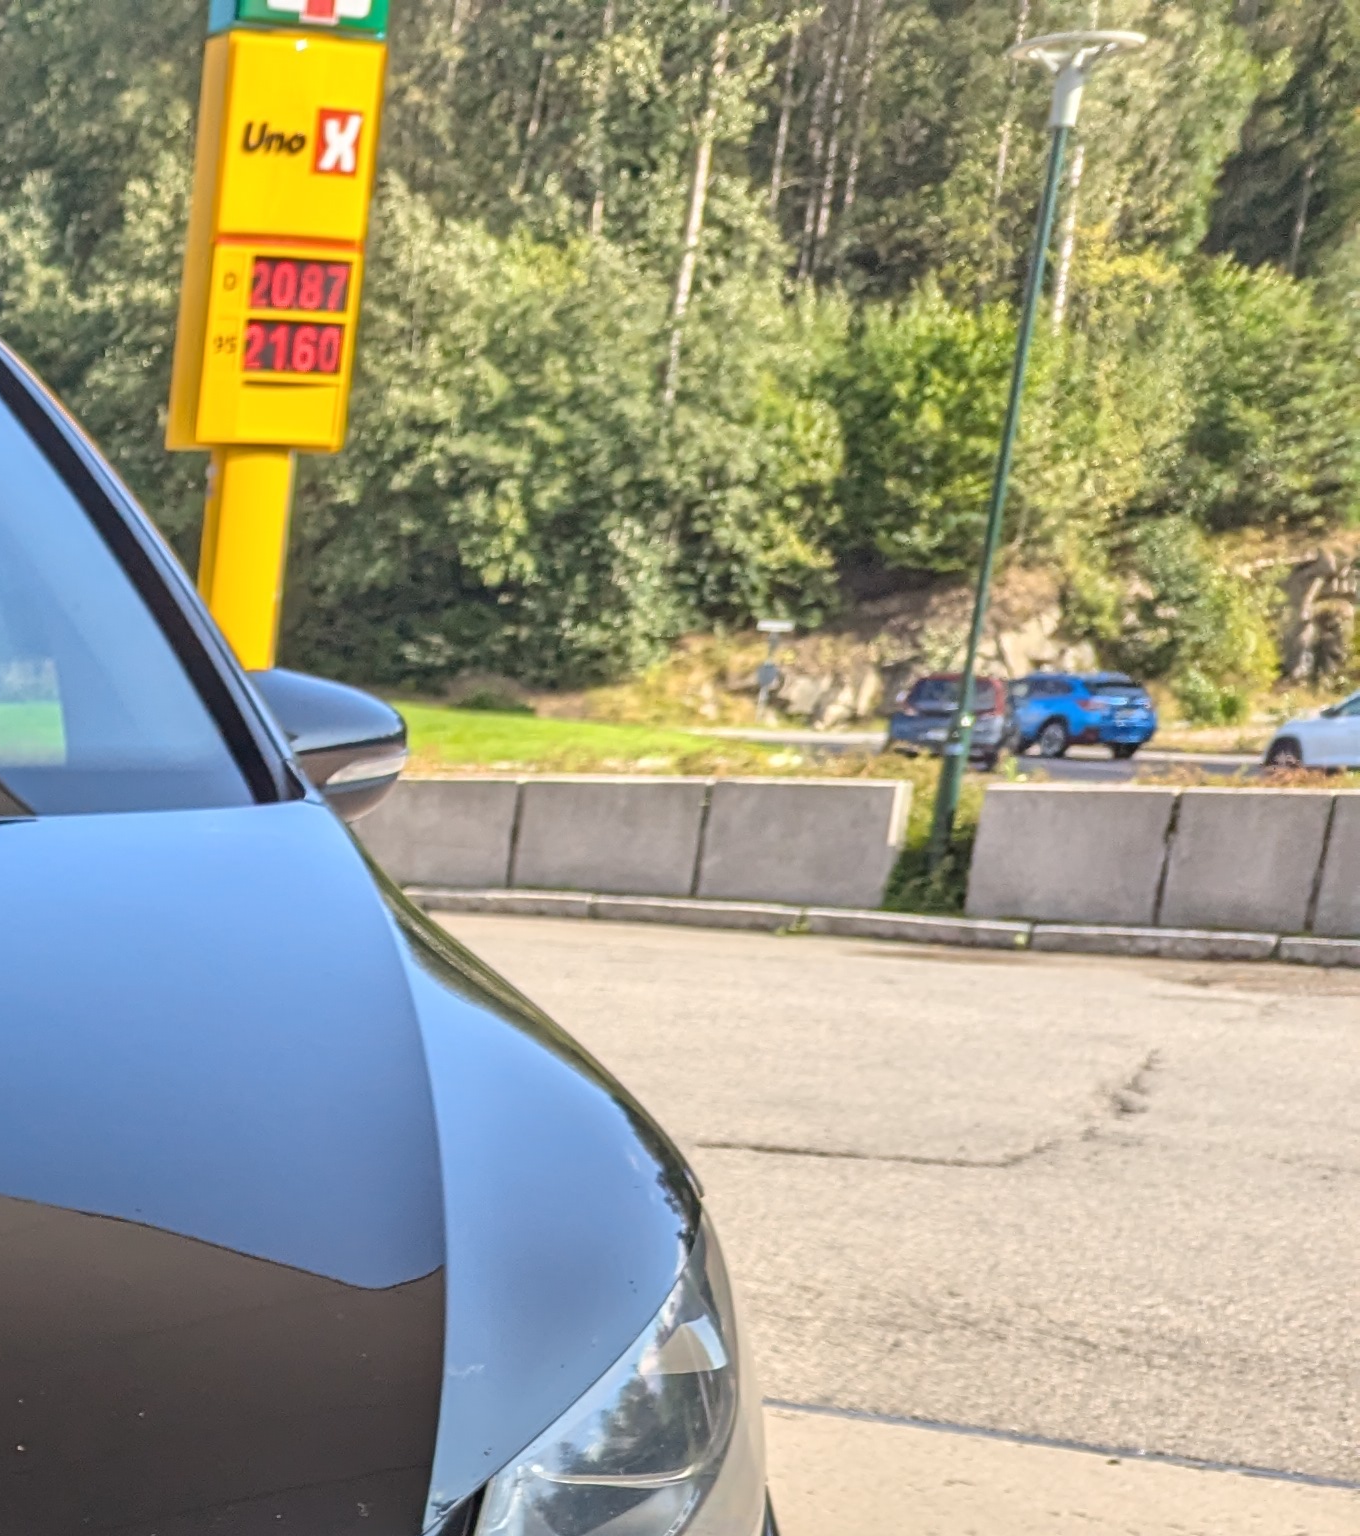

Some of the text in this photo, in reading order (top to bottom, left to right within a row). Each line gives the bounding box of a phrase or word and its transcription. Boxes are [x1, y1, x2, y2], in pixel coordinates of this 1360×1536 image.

[242, 113, 362, 173] Uno X
[250, 260, 349, 312] 2087
[243, 322, 342, 374] 2160
